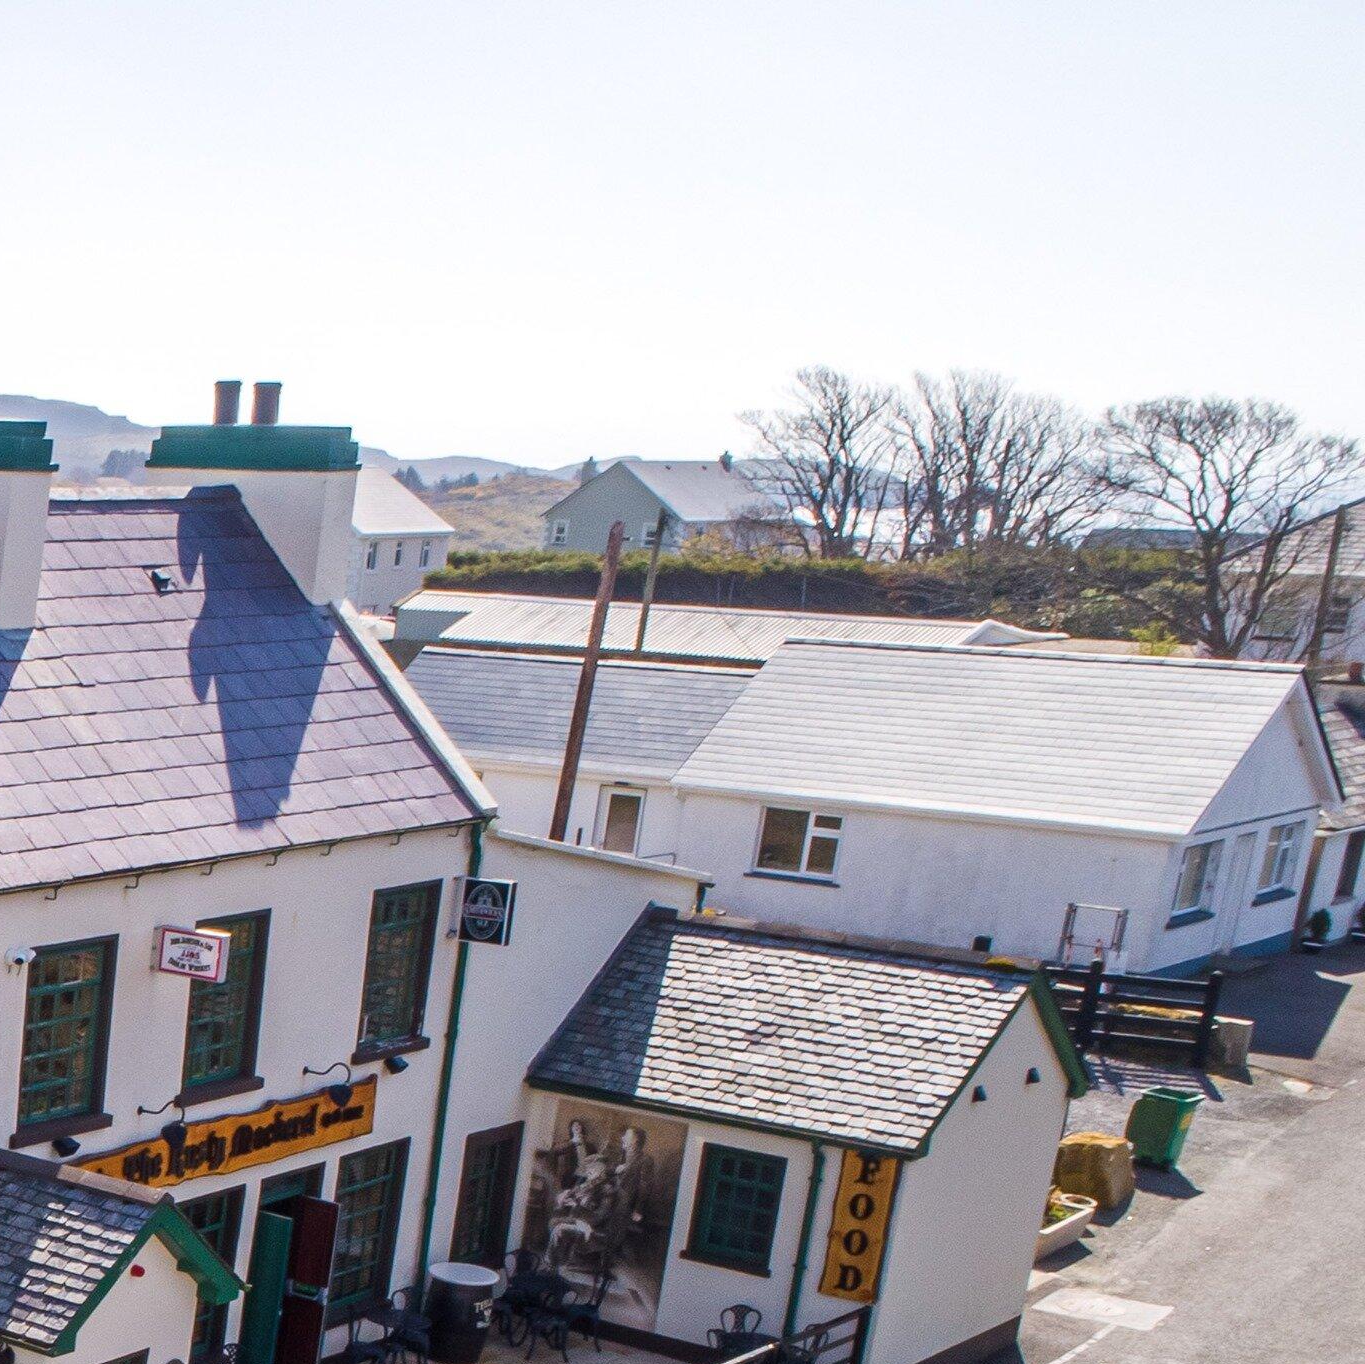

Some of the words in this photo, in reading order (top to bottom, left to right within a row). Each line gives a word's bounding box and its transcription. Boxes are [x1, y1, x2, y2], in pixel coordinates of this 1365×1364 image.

[122, 1147, 163, 1185] The
[229, 1103, 319, 1158] Mackerel
[834, 1153, 882, 1292] FOOD
